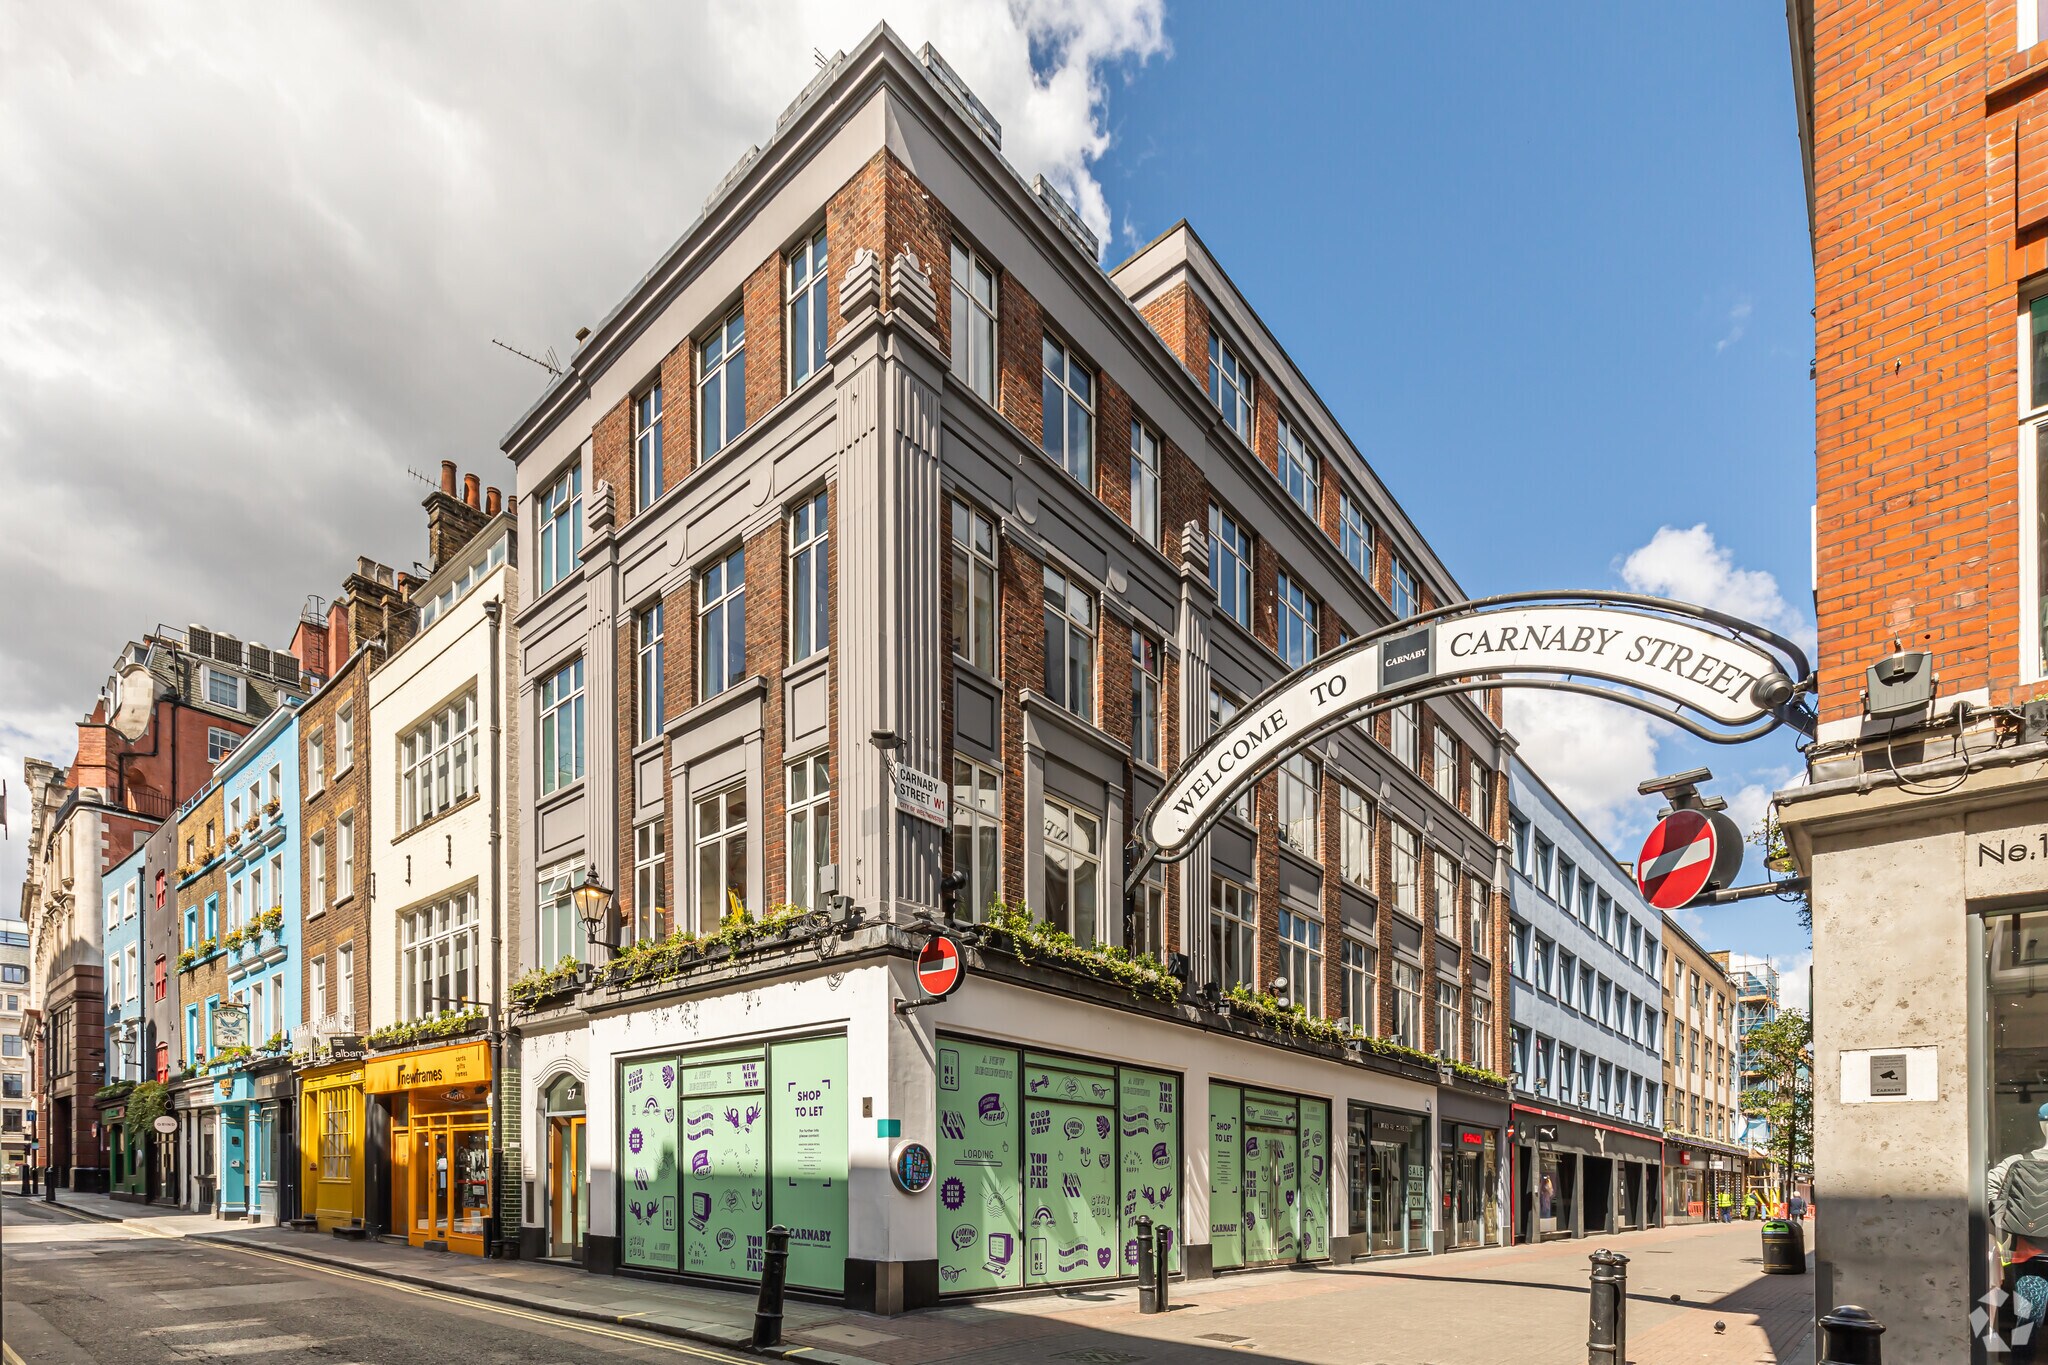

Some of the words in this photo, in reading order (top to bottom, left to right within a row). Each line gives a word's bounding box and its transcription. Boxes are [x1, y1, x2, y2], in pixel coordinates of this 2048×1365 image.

[1386, 648, 1427, 667] CARNABY
[1451, 625, 1623, 657] CARNABY
[1626, 635, 1758, 704] STREET
[1173, 708, 1288, 818] WELCOME
[1310, 675, 1347, 707] TO
[900, 768, 938, 794] CARNABY
[900, 784, 930, 804] STREET
[934, 796, 945, 811] W1
[916, 807, 944, 824] WESTMINSTER
[335, 1049, 364, 1058] albam
[401, 1068, 442, 1085] newframes
[1159, 1082, 1172, 1092] YOU
[568, 1088, 576, 1100] 27
[798, 1090, 821, 1101] SHOP
[1159, 1092, 1172, 1103] ARE
[795, 1107, 806, 1117] TO
[809, 1106, 823, 1117] LET
[1160, 1103, 1172, 1113] FAB
[984, 1112, 1004, 1121] AHEAD
[1031, 1110, 1050, 1119] GOOD
[1030, 1118, 1051, 1127] VIBES
[1216, 1123, 1231, 1131] SHOP
[1031, 1126, 1050, 1135] ONLY
[964, 1150, 994, 1159] LOADING
[1030, 1153, 1048, 1164] YOU
[1156, 1157, 1170, 1166] AHEAD
[696, 1166, 712, 1176] AHEAD
[1030, 1166, 1048, 1176] ARE
[1409, 1166, 1423, 1176] SALE
[1030, 1178, 1048, 1188] FAB
[1409, 1183, 1422, 1192] NOW
[1127, 1189, 1136, 1201] GO
[1091, 1196, 1110, 1205] STAY
[1412, 1197, 1420, 1206] ON
[1091, 1206, 1111, 1218] COOL
[1124, 1202, 1136, 1216] GET
[956, 1228, 975, 1238] LOOKING
[1212, 1224, 1237, 1232] CARNABY
[790, 1228, 831, 1242] CARNABY
[746, 1235, 763, 1247] YOU
[746, 1248, 763, 1260] ARE
[746, 1260, 763, 1272] FAB
